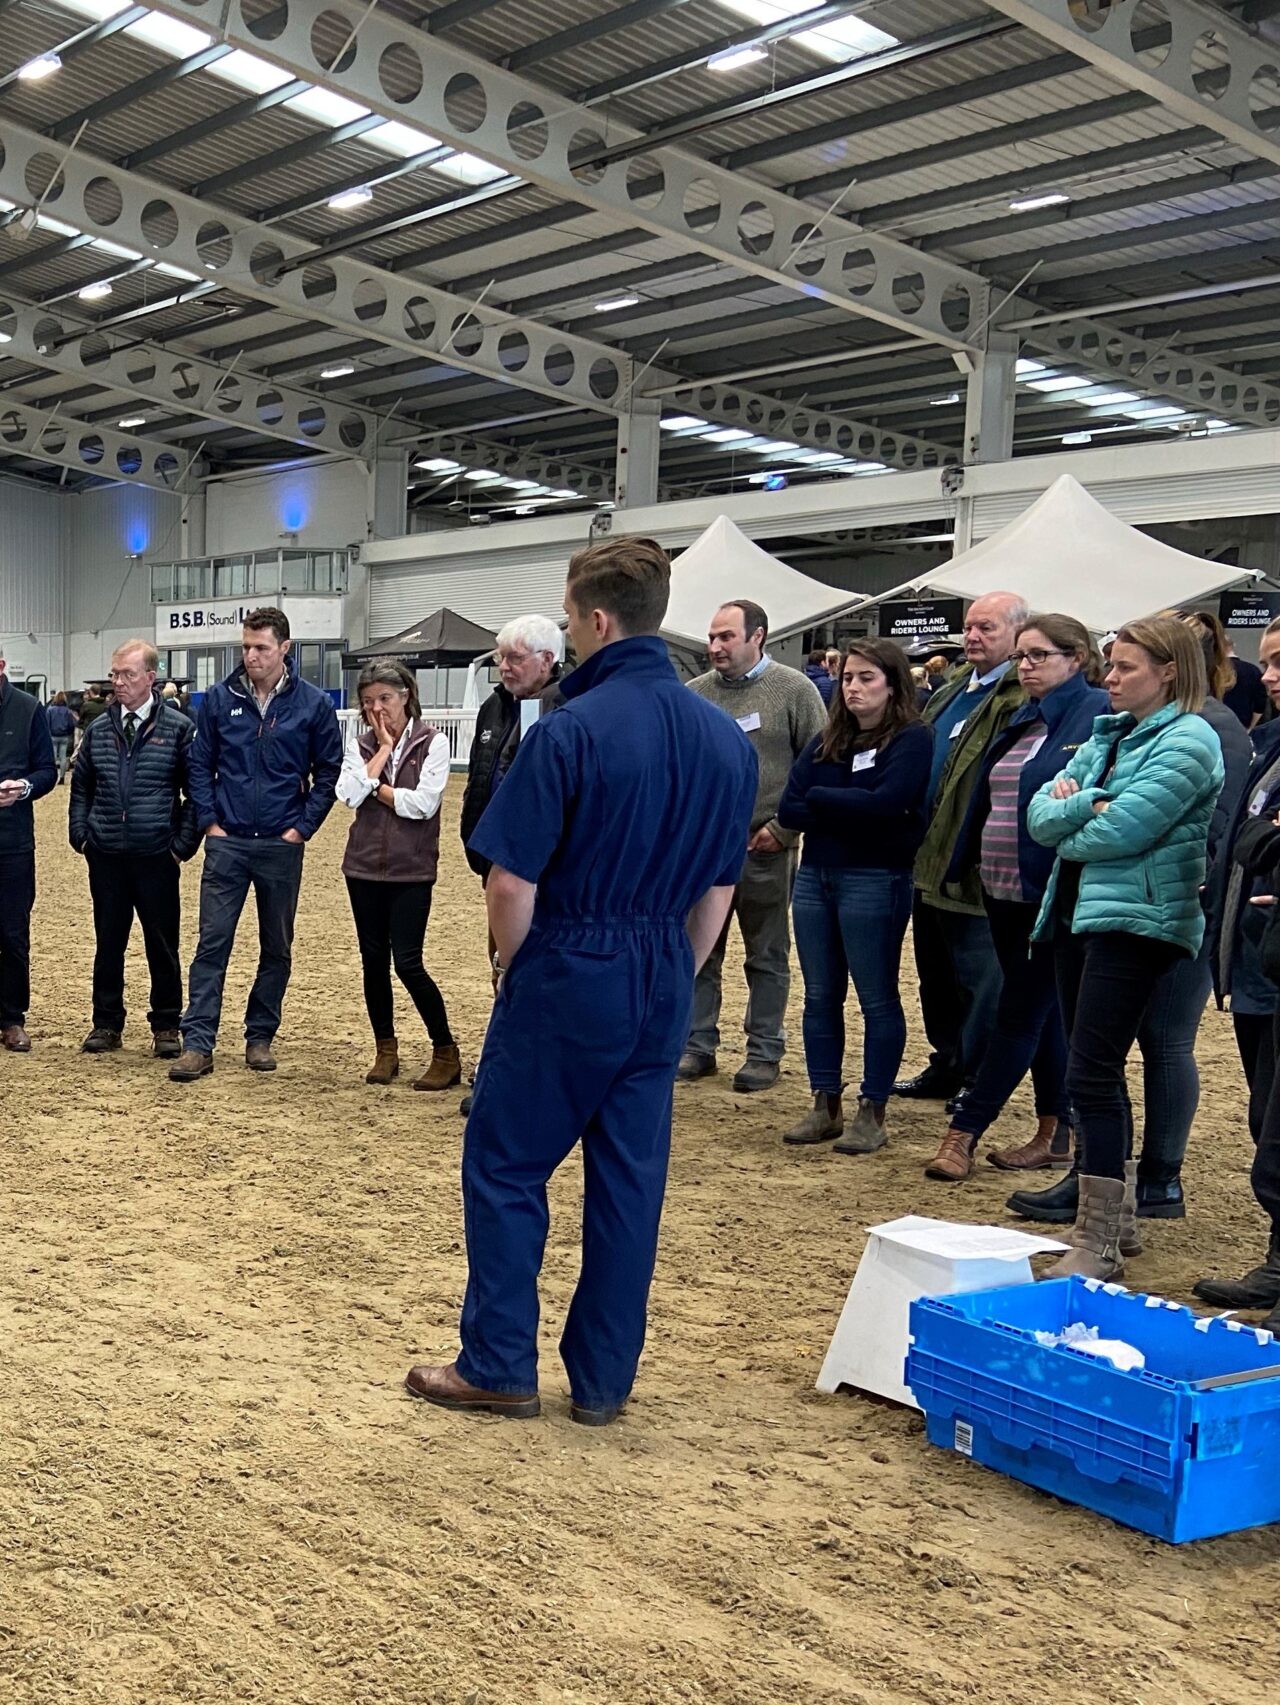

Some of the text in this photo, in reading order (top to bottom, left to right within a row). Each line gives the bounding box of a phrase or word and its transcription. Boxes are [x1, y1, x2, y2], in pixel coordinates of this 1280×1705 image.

[1231, 609, 1270, 617] OWNERS AND
[170, 611, 206, 629] B.S.B.
[207, 609, 238, 628] (Sound)
[894, 616, 946, 627] OWNERS AND
[1228, 617, 1271, 625] RIDERS LOUNGE
[890, 625, 950, 635] RIDERS LOUNGE
